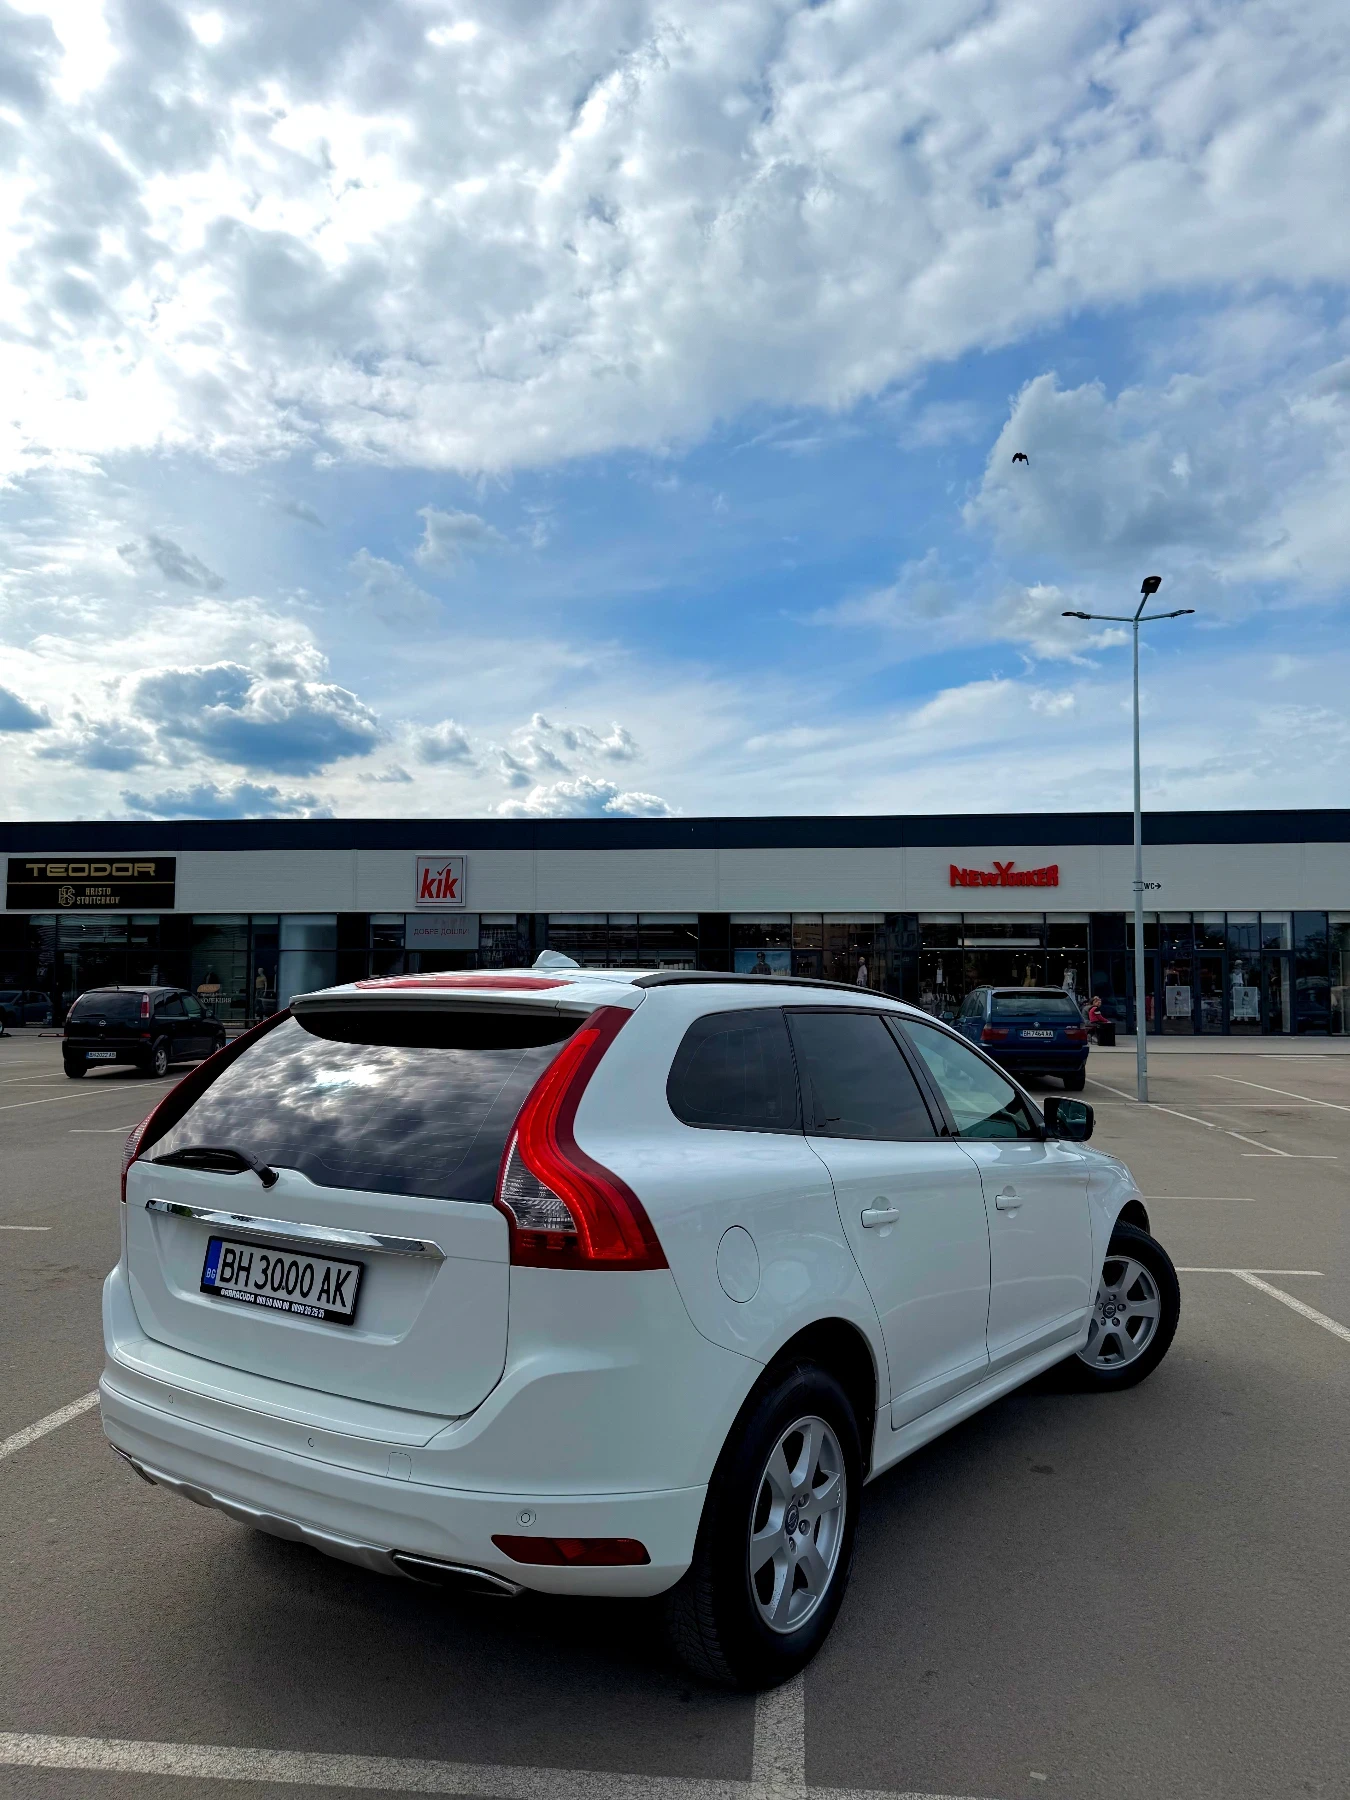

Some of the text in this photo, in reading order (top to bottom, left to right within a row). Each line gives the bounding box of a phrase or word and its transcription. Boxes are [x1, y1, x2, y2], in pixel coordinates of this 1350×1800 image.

[25, 863, 156, 877] TEODOR
[420, 865, 458, 898] kik
[1143, 882, 1155, 890] WC
[85, 887, 112, 896] HRISTO
[413, 928, 439, 936] ДОБРЕ
[205, 1268, 217, 1279] BG
[219, 1248, 353, 1307] BH 3000 AK
[220, 1289, 255, 1303] BARRACUDA
